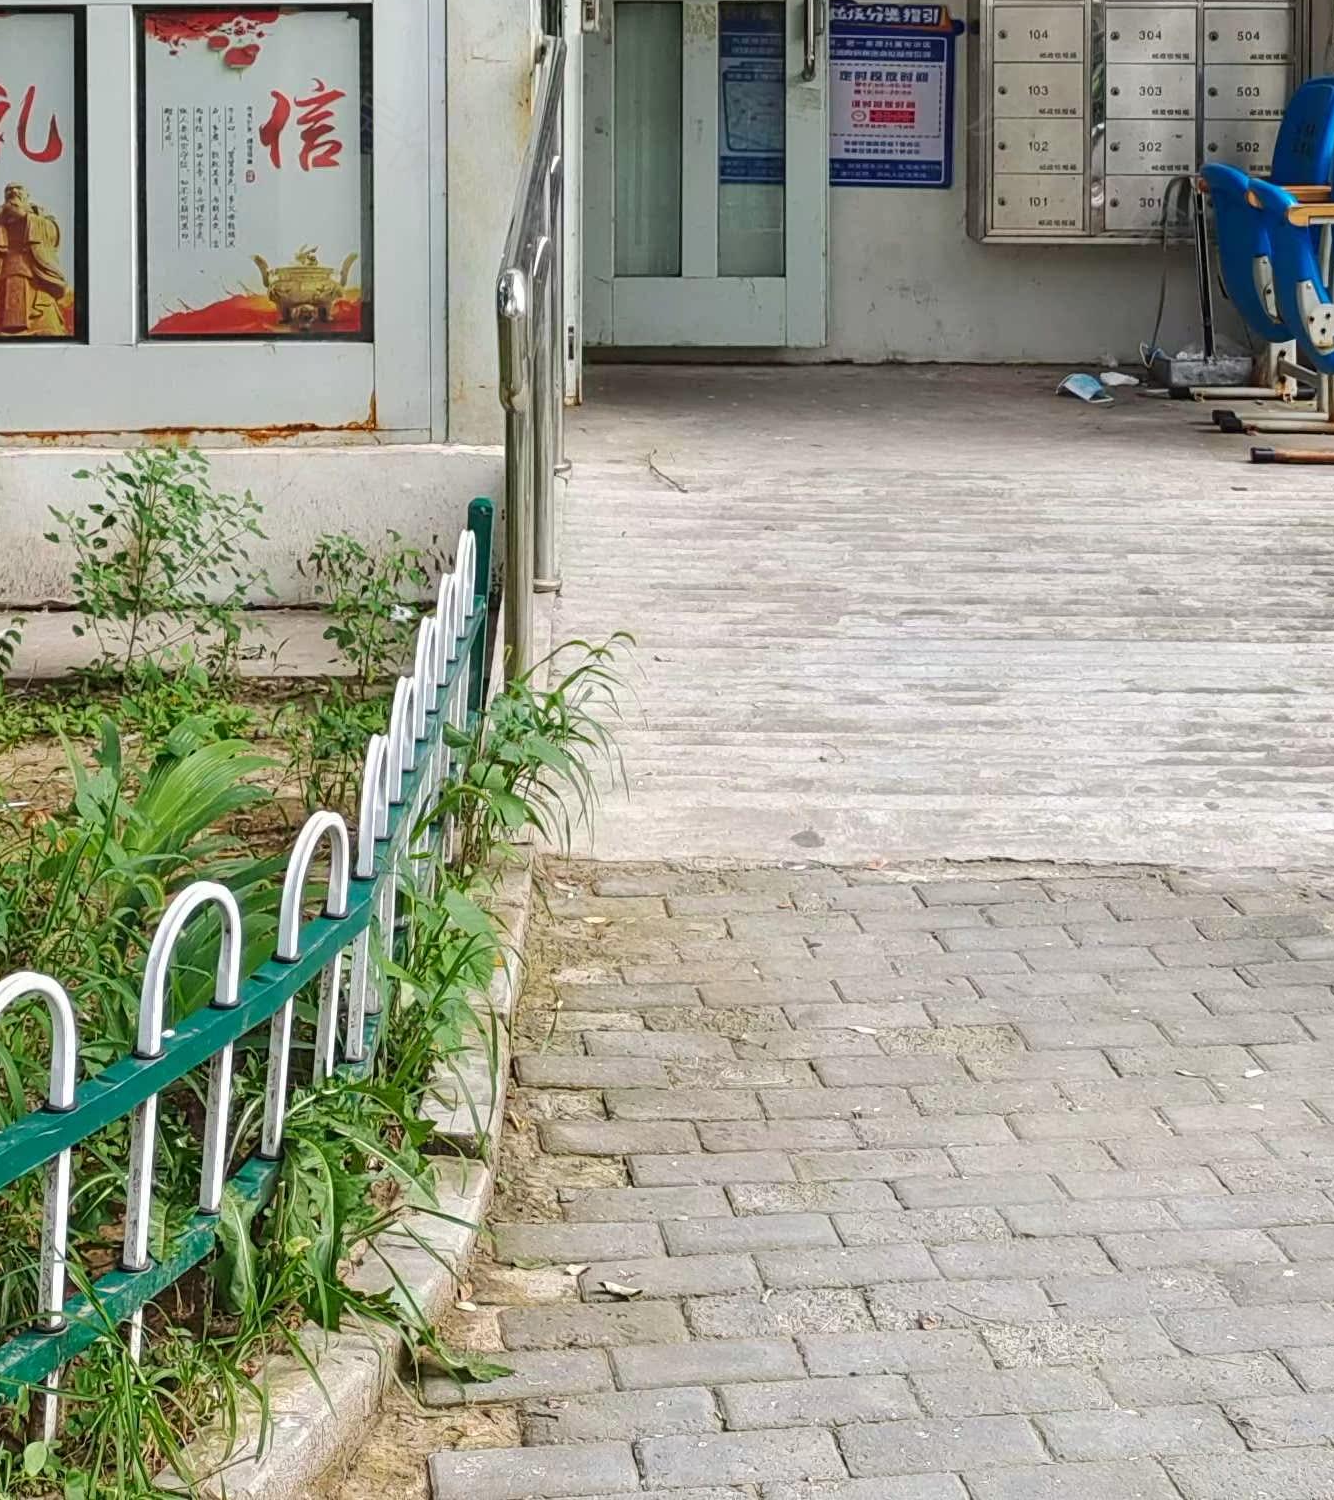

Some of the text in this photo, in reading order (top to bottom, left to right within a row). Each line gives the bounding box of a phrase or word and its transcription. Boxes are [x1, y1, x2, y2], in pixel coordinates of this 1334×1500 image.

[1029, 29, 1049, 40] 104
[1138, 30, 1162, 41] 304
[1236, 30, 1260, 42] 504
[1028, 85, 1049, 96] 103
[1139, 86, 1162, 97] 303
[1236, 86, 1260, 98] 503
[258, 77, 347, 173] 信
[1028, 140, 1049, 152] 102
[1138, 141, 1162, 152] 302
[1235, 141, 1260, 153] 502
[1029, 196, 1048, 207] 101
[1139, 196, 1162, 207] 301
